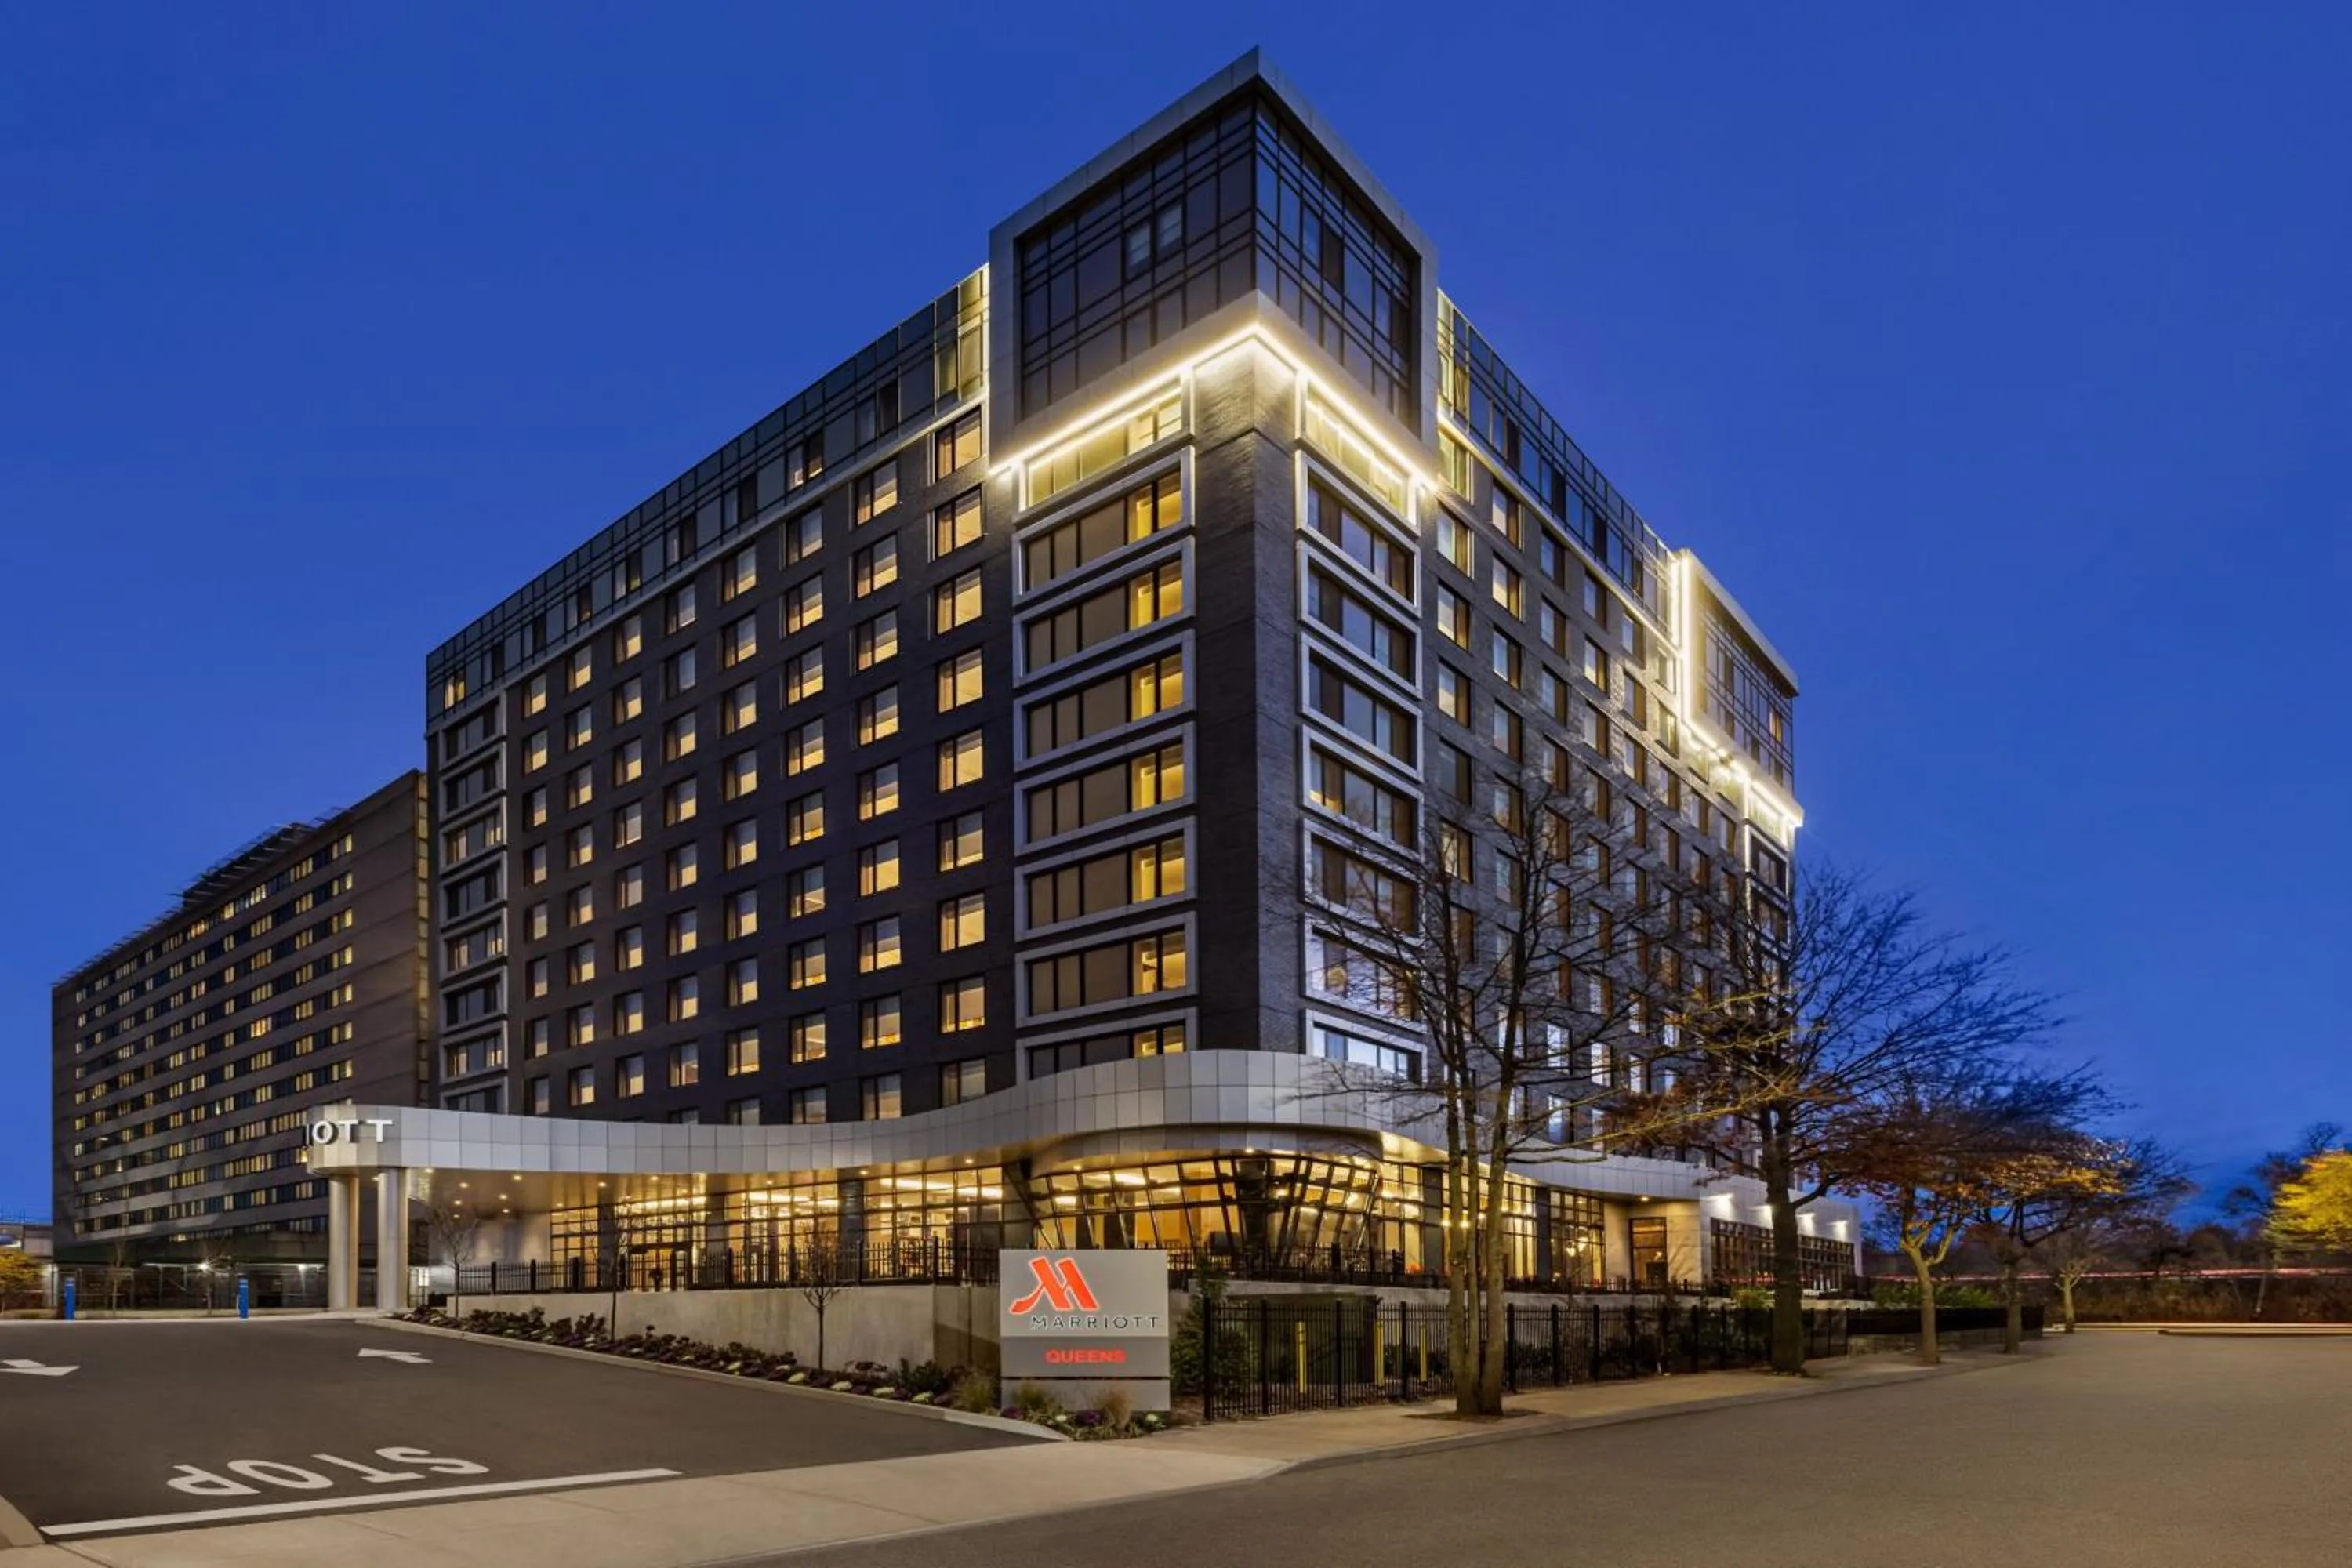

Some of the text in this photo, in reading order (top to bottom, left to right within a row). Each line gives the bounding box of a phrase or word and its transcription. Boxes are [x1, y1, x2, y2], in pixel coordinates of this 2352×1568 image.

[1031, 1316, 1160, 1329] MARRIOTT
[1045, 1348, 1127, 1364] QUEENS
[166, 1446, 490, 1495] STOP
